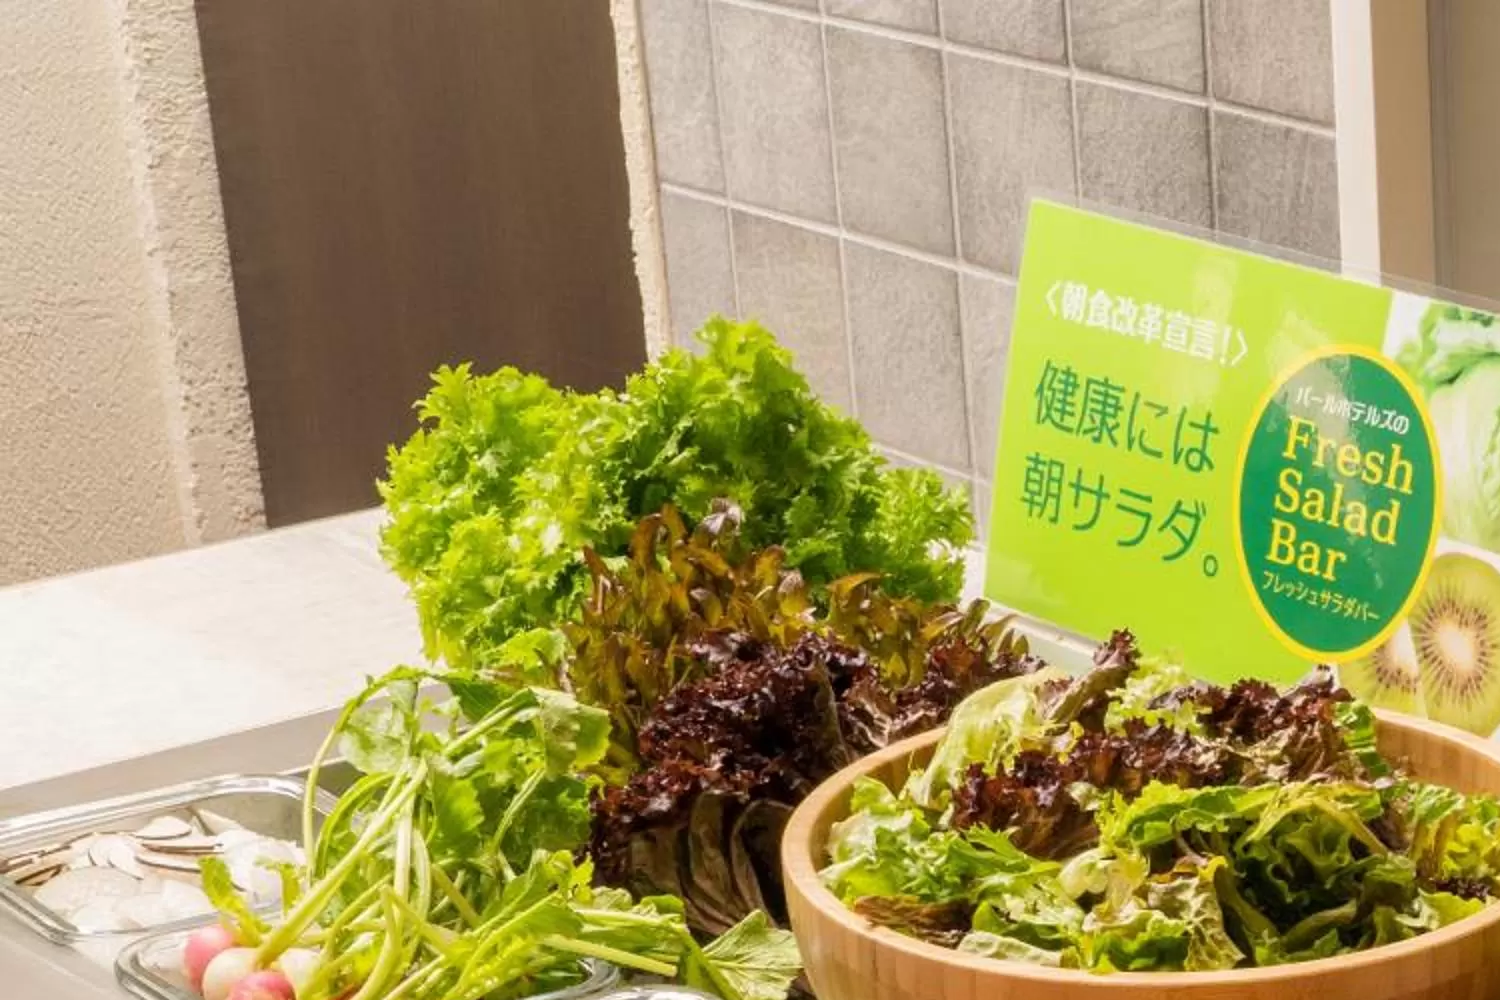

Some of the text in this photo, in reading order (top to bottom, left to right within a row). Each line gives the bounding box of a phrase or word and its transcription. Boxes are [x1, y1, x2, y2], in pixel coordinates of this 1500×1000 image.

[1034, 359, 1220, 473] 健康には
[1282, 415, 1414, 496] Fresh
[1020, 451, 1219, 578] 朝サラダ。
[1274, 467, 1401, 547] Salad
[1265, 518, 1347, 582] Bar
[1262, 570, 1380, 622] フレッシュサラダバー
